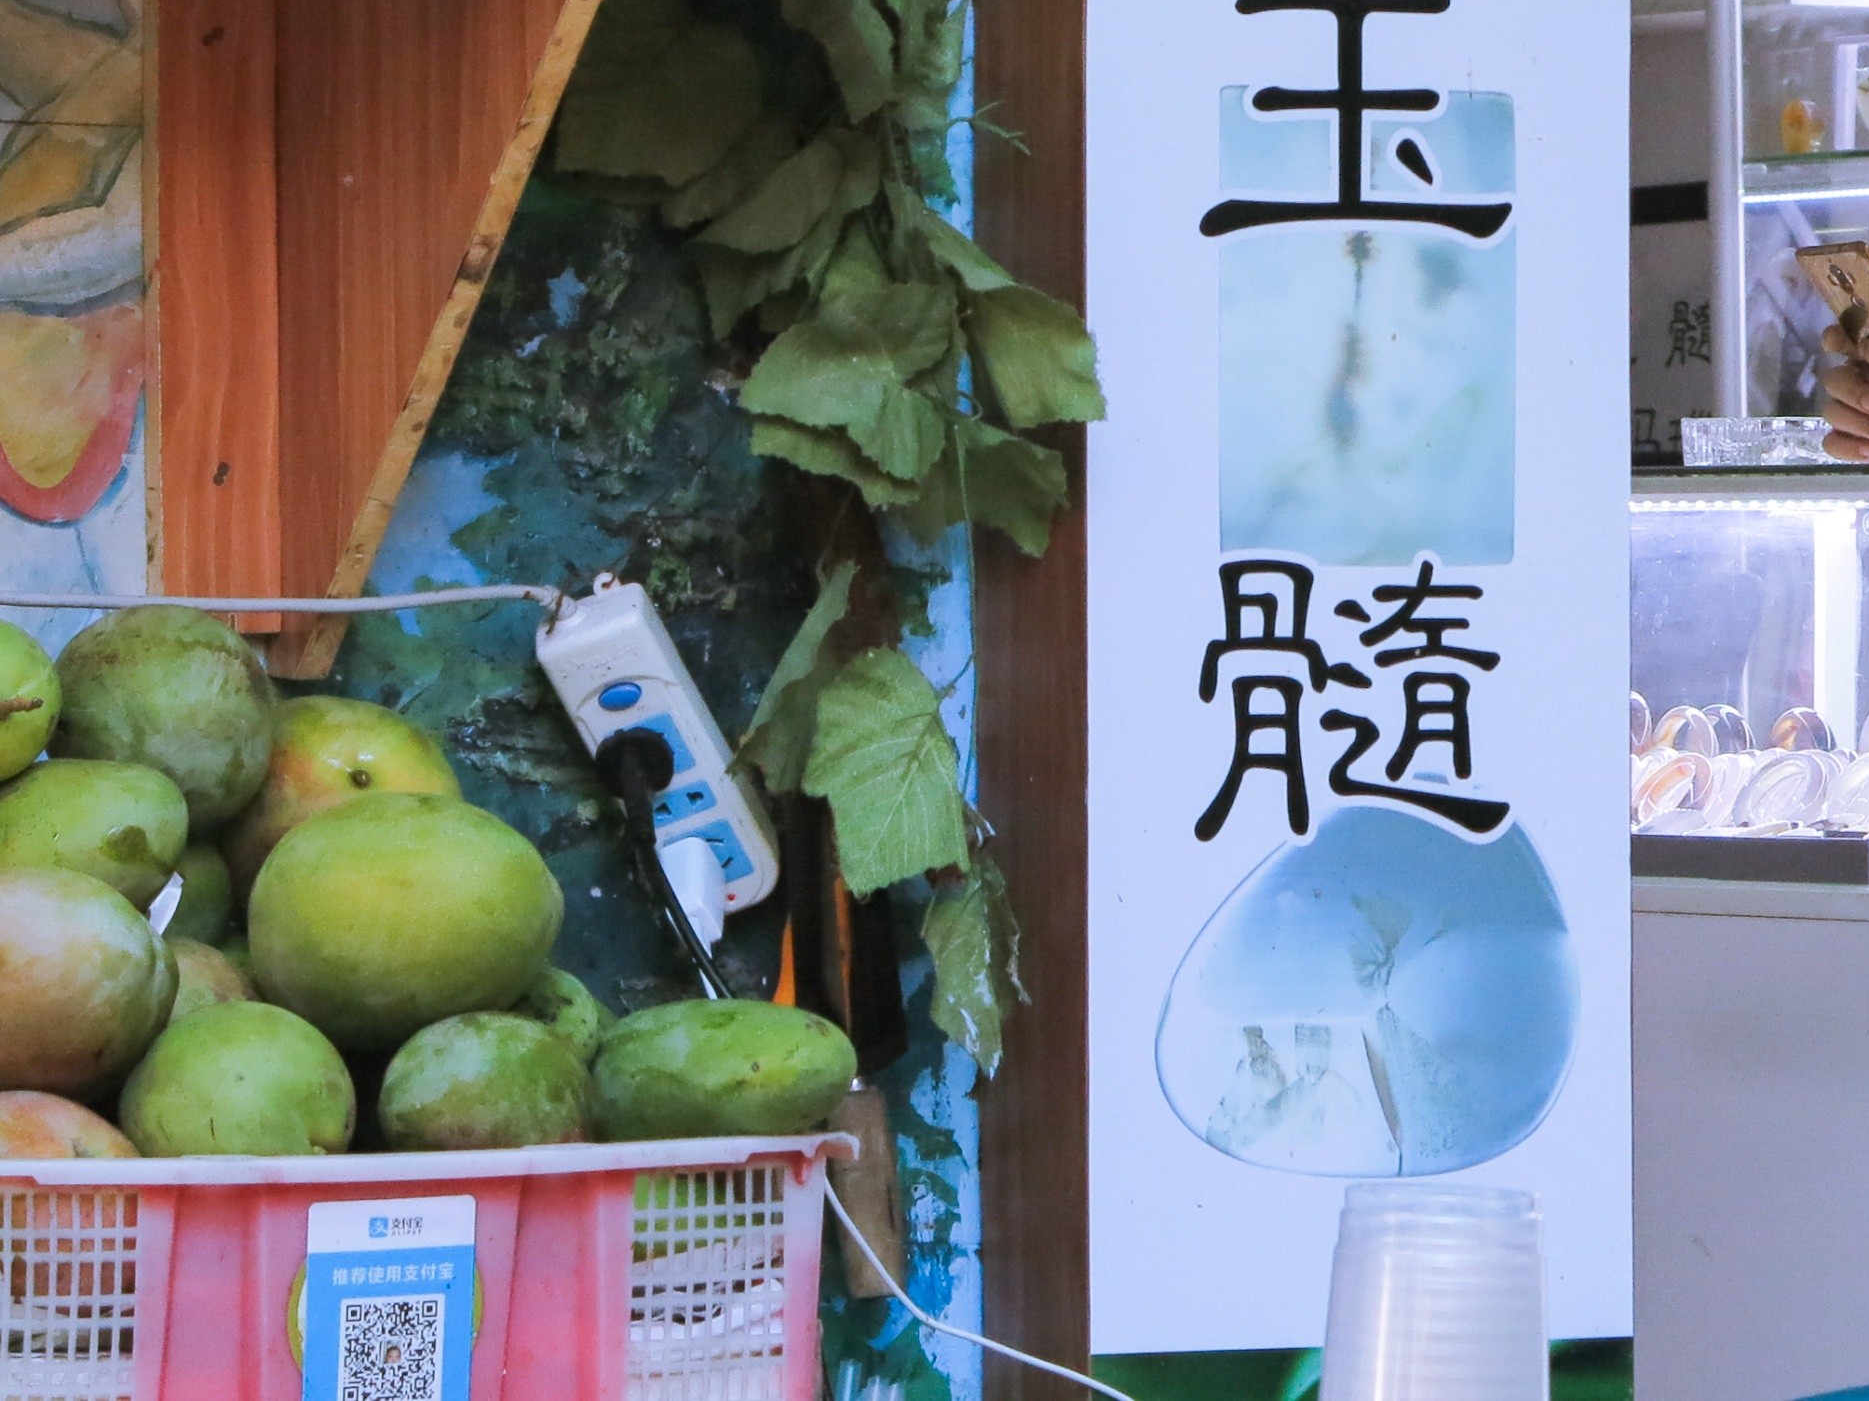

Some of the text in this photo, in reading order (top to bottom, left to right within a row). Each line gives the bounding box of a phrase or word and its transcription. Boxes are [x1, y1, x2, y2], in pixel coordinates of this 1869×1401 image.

[391, 1216, 423, 1229] 支付宝
[332, 1262, 455, 1286] 推荐使用支付宝
